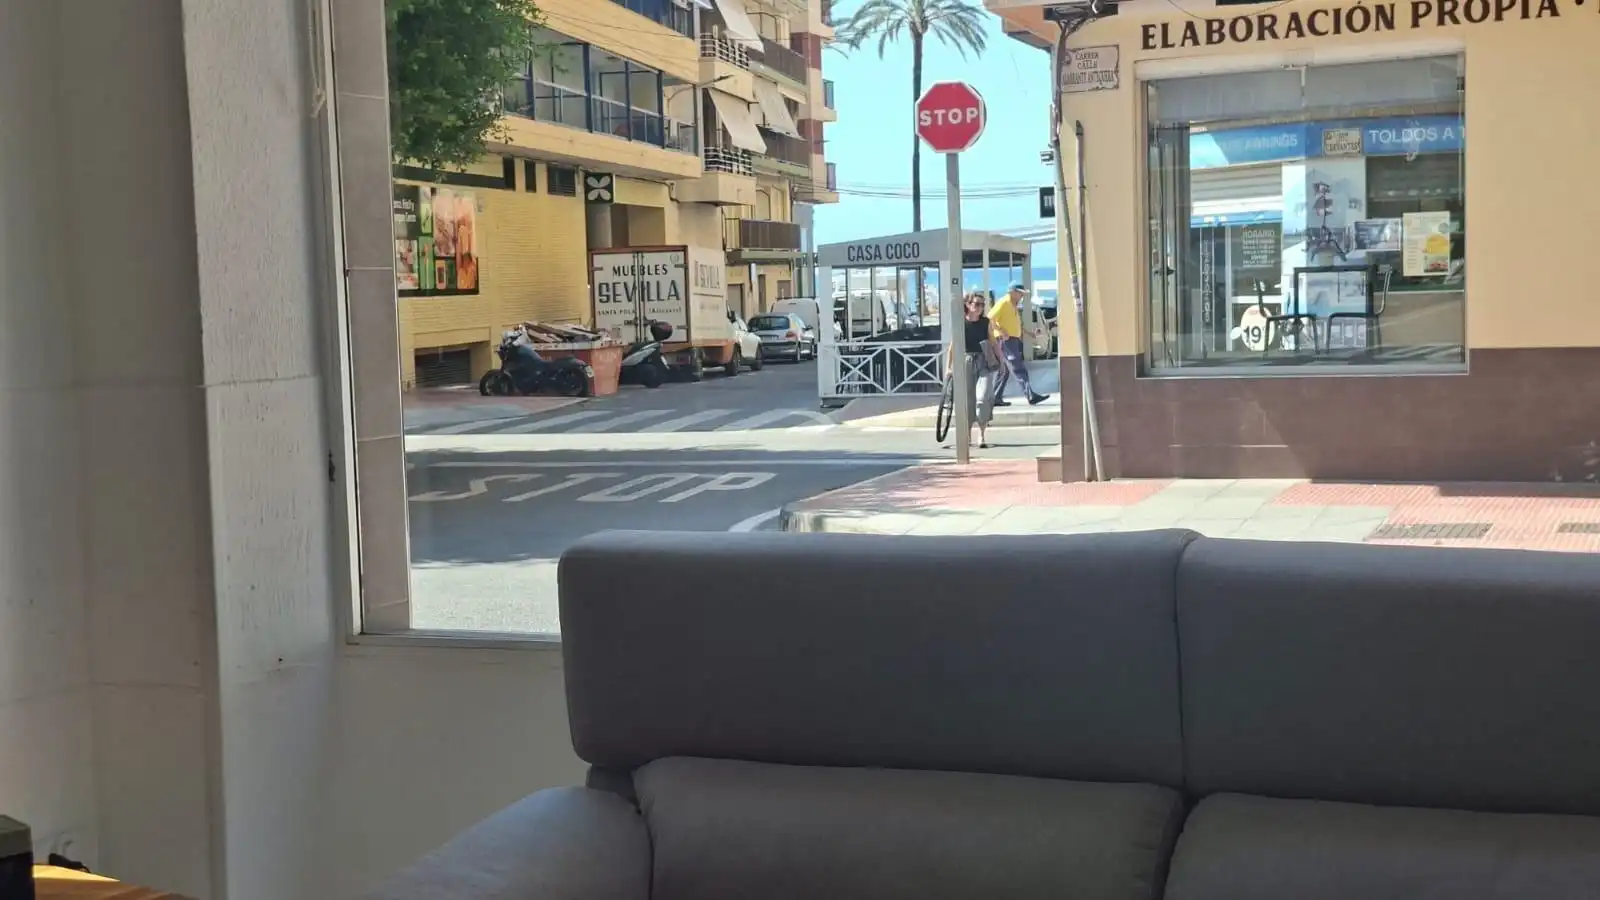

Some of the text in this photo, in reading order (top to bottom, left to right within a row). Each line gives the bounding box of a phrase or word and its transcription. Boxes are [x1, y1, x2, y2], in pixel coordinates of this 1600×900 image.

[1141, 0, 1560, 50] ELABORACIÓN PROPIA
[920, 107, 978, 126] STOP
[1369, 126, 1437, 145] TOLDOS
[847, 242, 920, 262] CASA COCO
[613, 264, 668, 277] MUEBLES
[599, 280, 681, 303] SEVILLA
[408, 473, 777, 502] STOP
